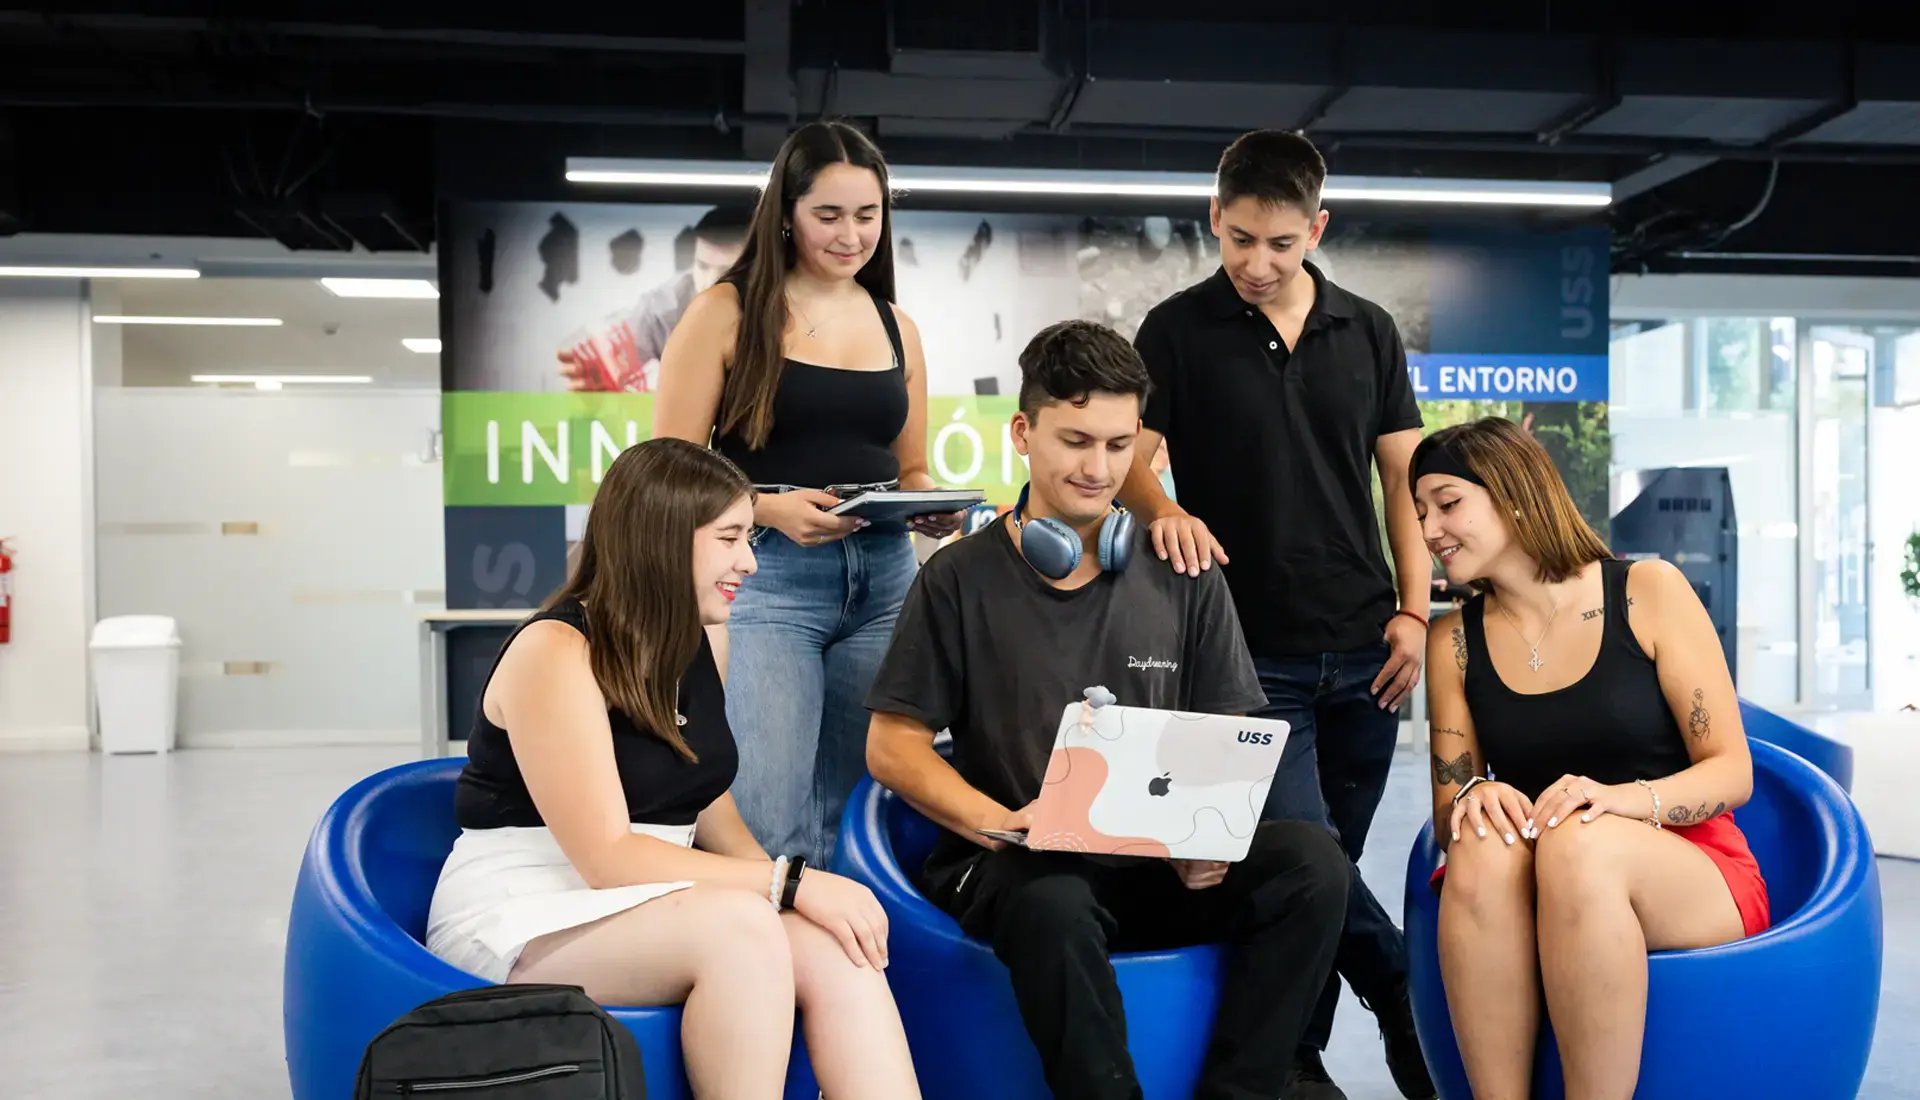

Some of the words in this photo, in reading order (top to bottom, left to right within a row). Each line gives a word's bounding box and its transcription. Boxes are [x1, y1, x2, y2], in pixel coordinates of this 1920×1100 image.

[1439, 366, 1578, 393] ENTORNO
[1127, 655, 1178, 673] Daydreaming
[1237, 730, 1273, 745] USS
